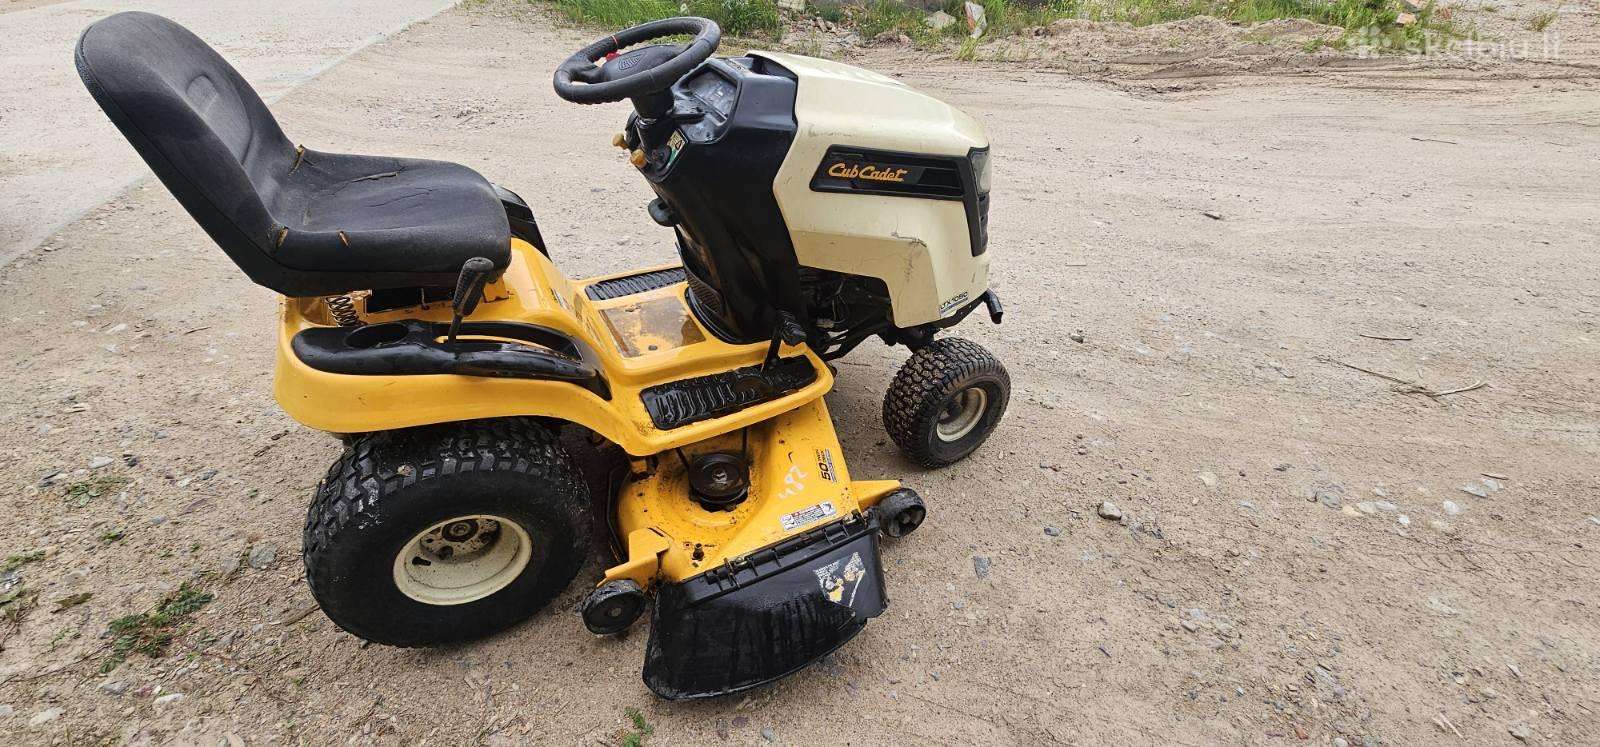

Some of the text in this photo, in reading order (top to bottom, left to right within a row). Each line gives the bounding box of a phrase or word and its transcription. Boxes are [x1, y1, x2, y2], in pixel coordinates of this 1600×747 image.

[828, 162, 908, 182] Cub Cadet
[818, 462, 831, 481] 50
